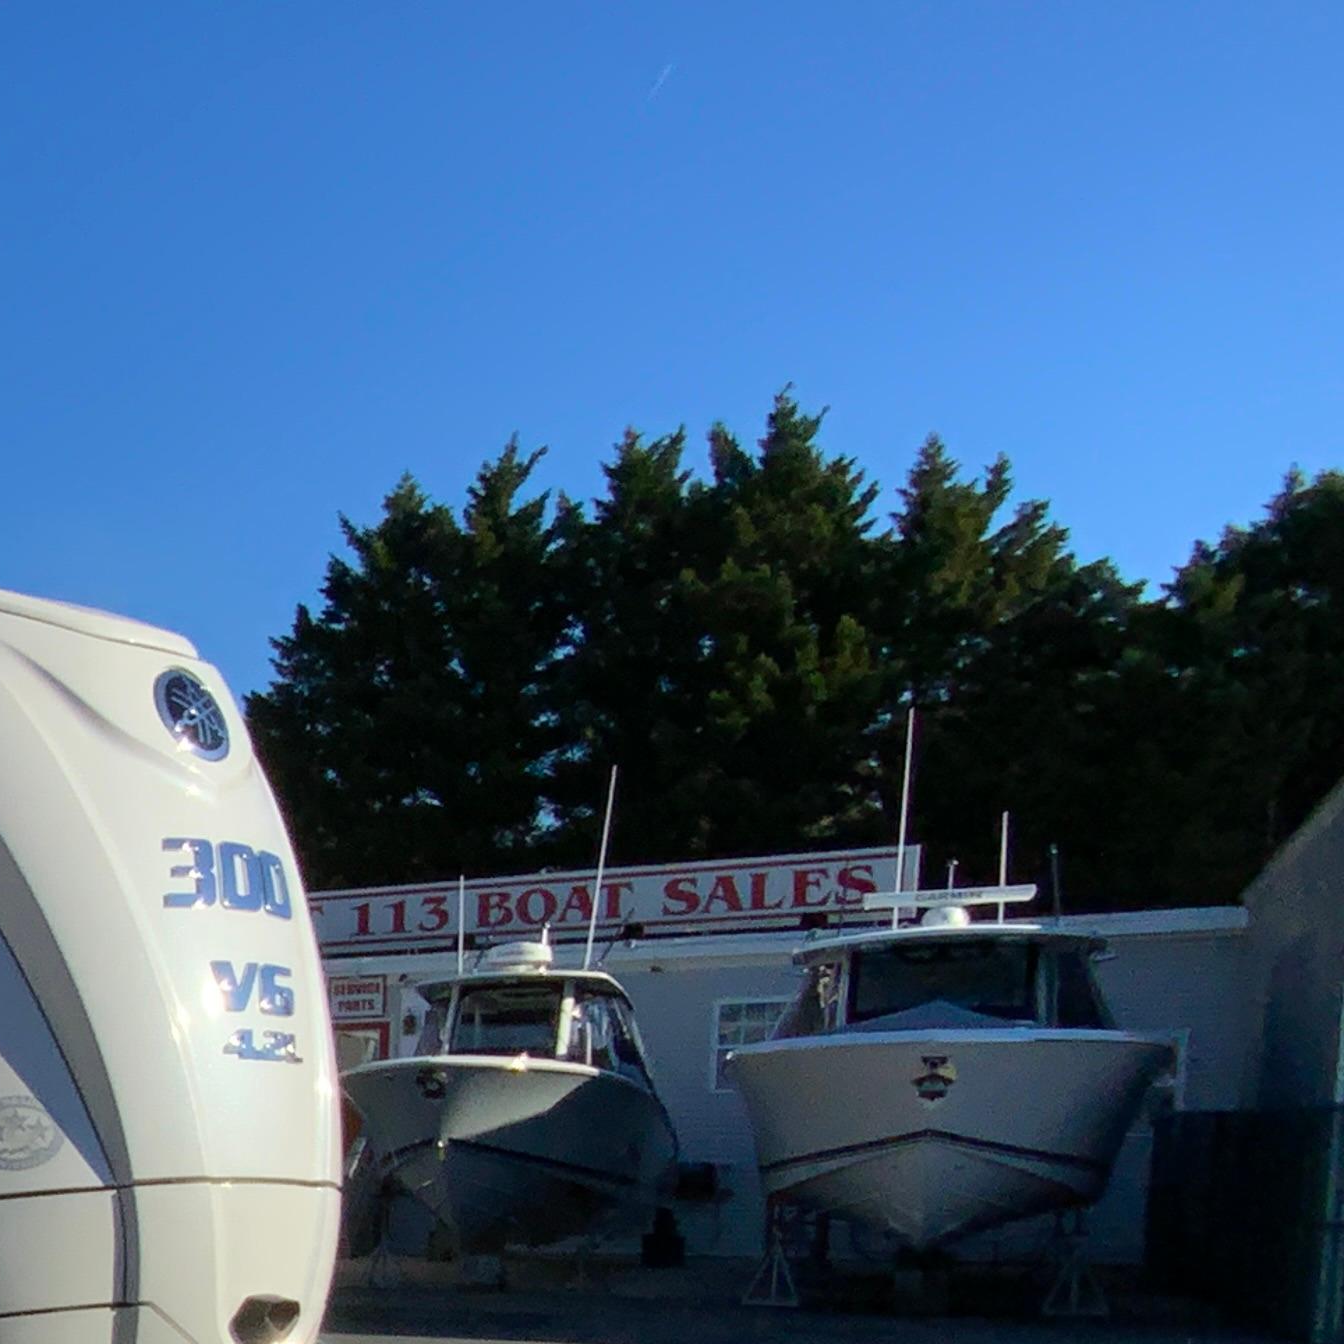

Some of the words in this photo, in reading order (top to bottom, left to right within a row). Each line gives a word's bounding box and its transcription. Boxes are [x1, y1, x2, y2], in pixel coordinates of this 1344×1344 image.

[160, 837, 292, 920] 300
[352, 897, 450, 936] 113
[476, 882, 633, 927] BOAT
[662, 865, 878, 916] SALES
[209, 960, 294, 1017] V6
